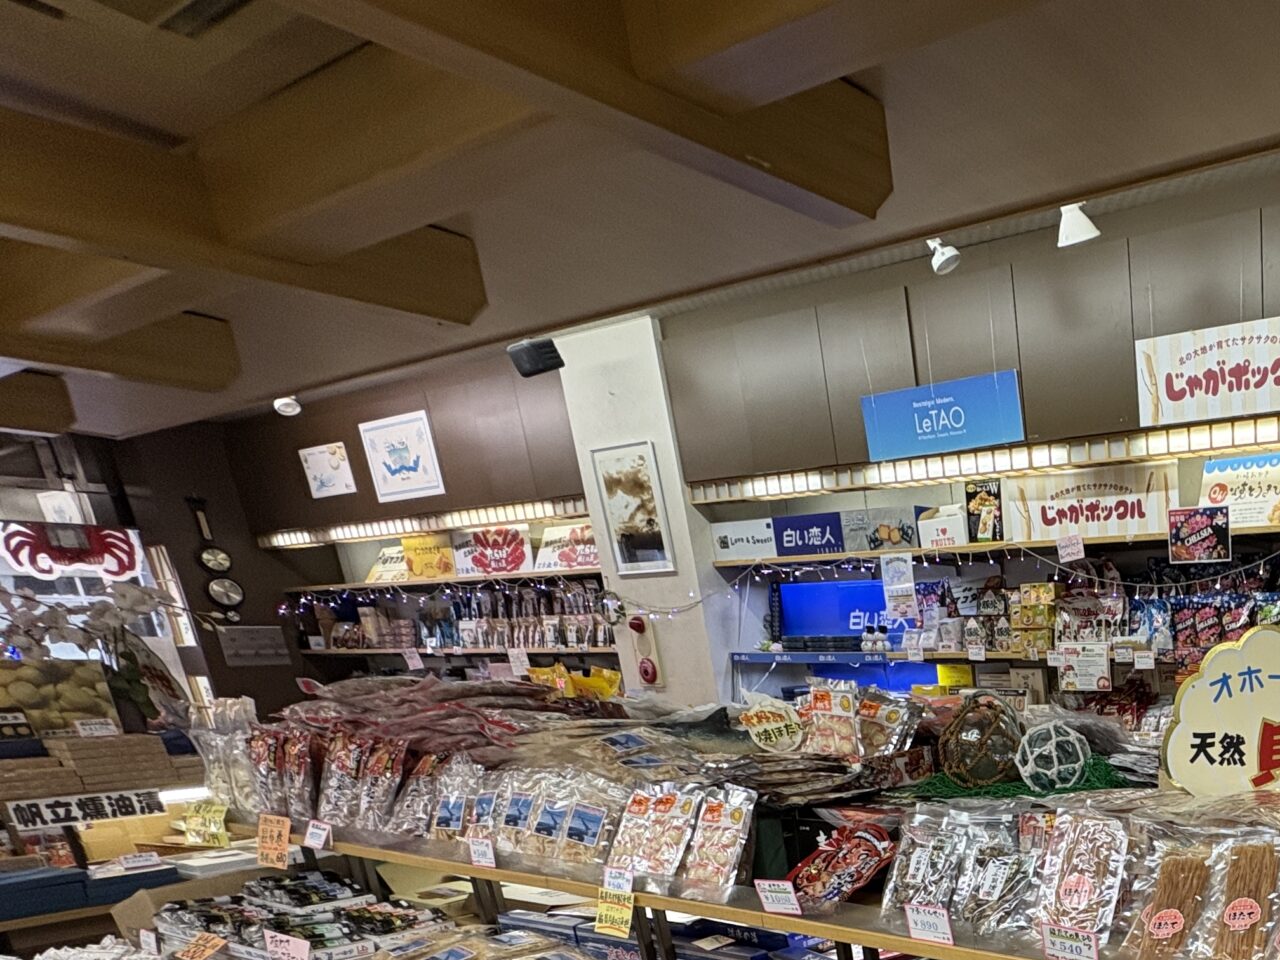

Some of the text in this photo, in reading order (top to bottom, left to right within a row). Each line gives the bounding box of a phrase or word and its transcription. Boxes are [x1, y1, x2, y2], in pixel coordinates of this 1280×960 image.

[914, 406, 965, 434] LeTAO
[1041, 498, 1146, 527] じゃがポックル
[783, 526, 835, 547] 白い恋人
[1184, 527, 1214, 546] CHELSEA
[1189, 731, 1247, 767] 天然
[1153, 919, 1179, 930] ほたて
[1228, 910, 1255, 921] ほたて
[1050, 938, 1082, 956] ¥540
